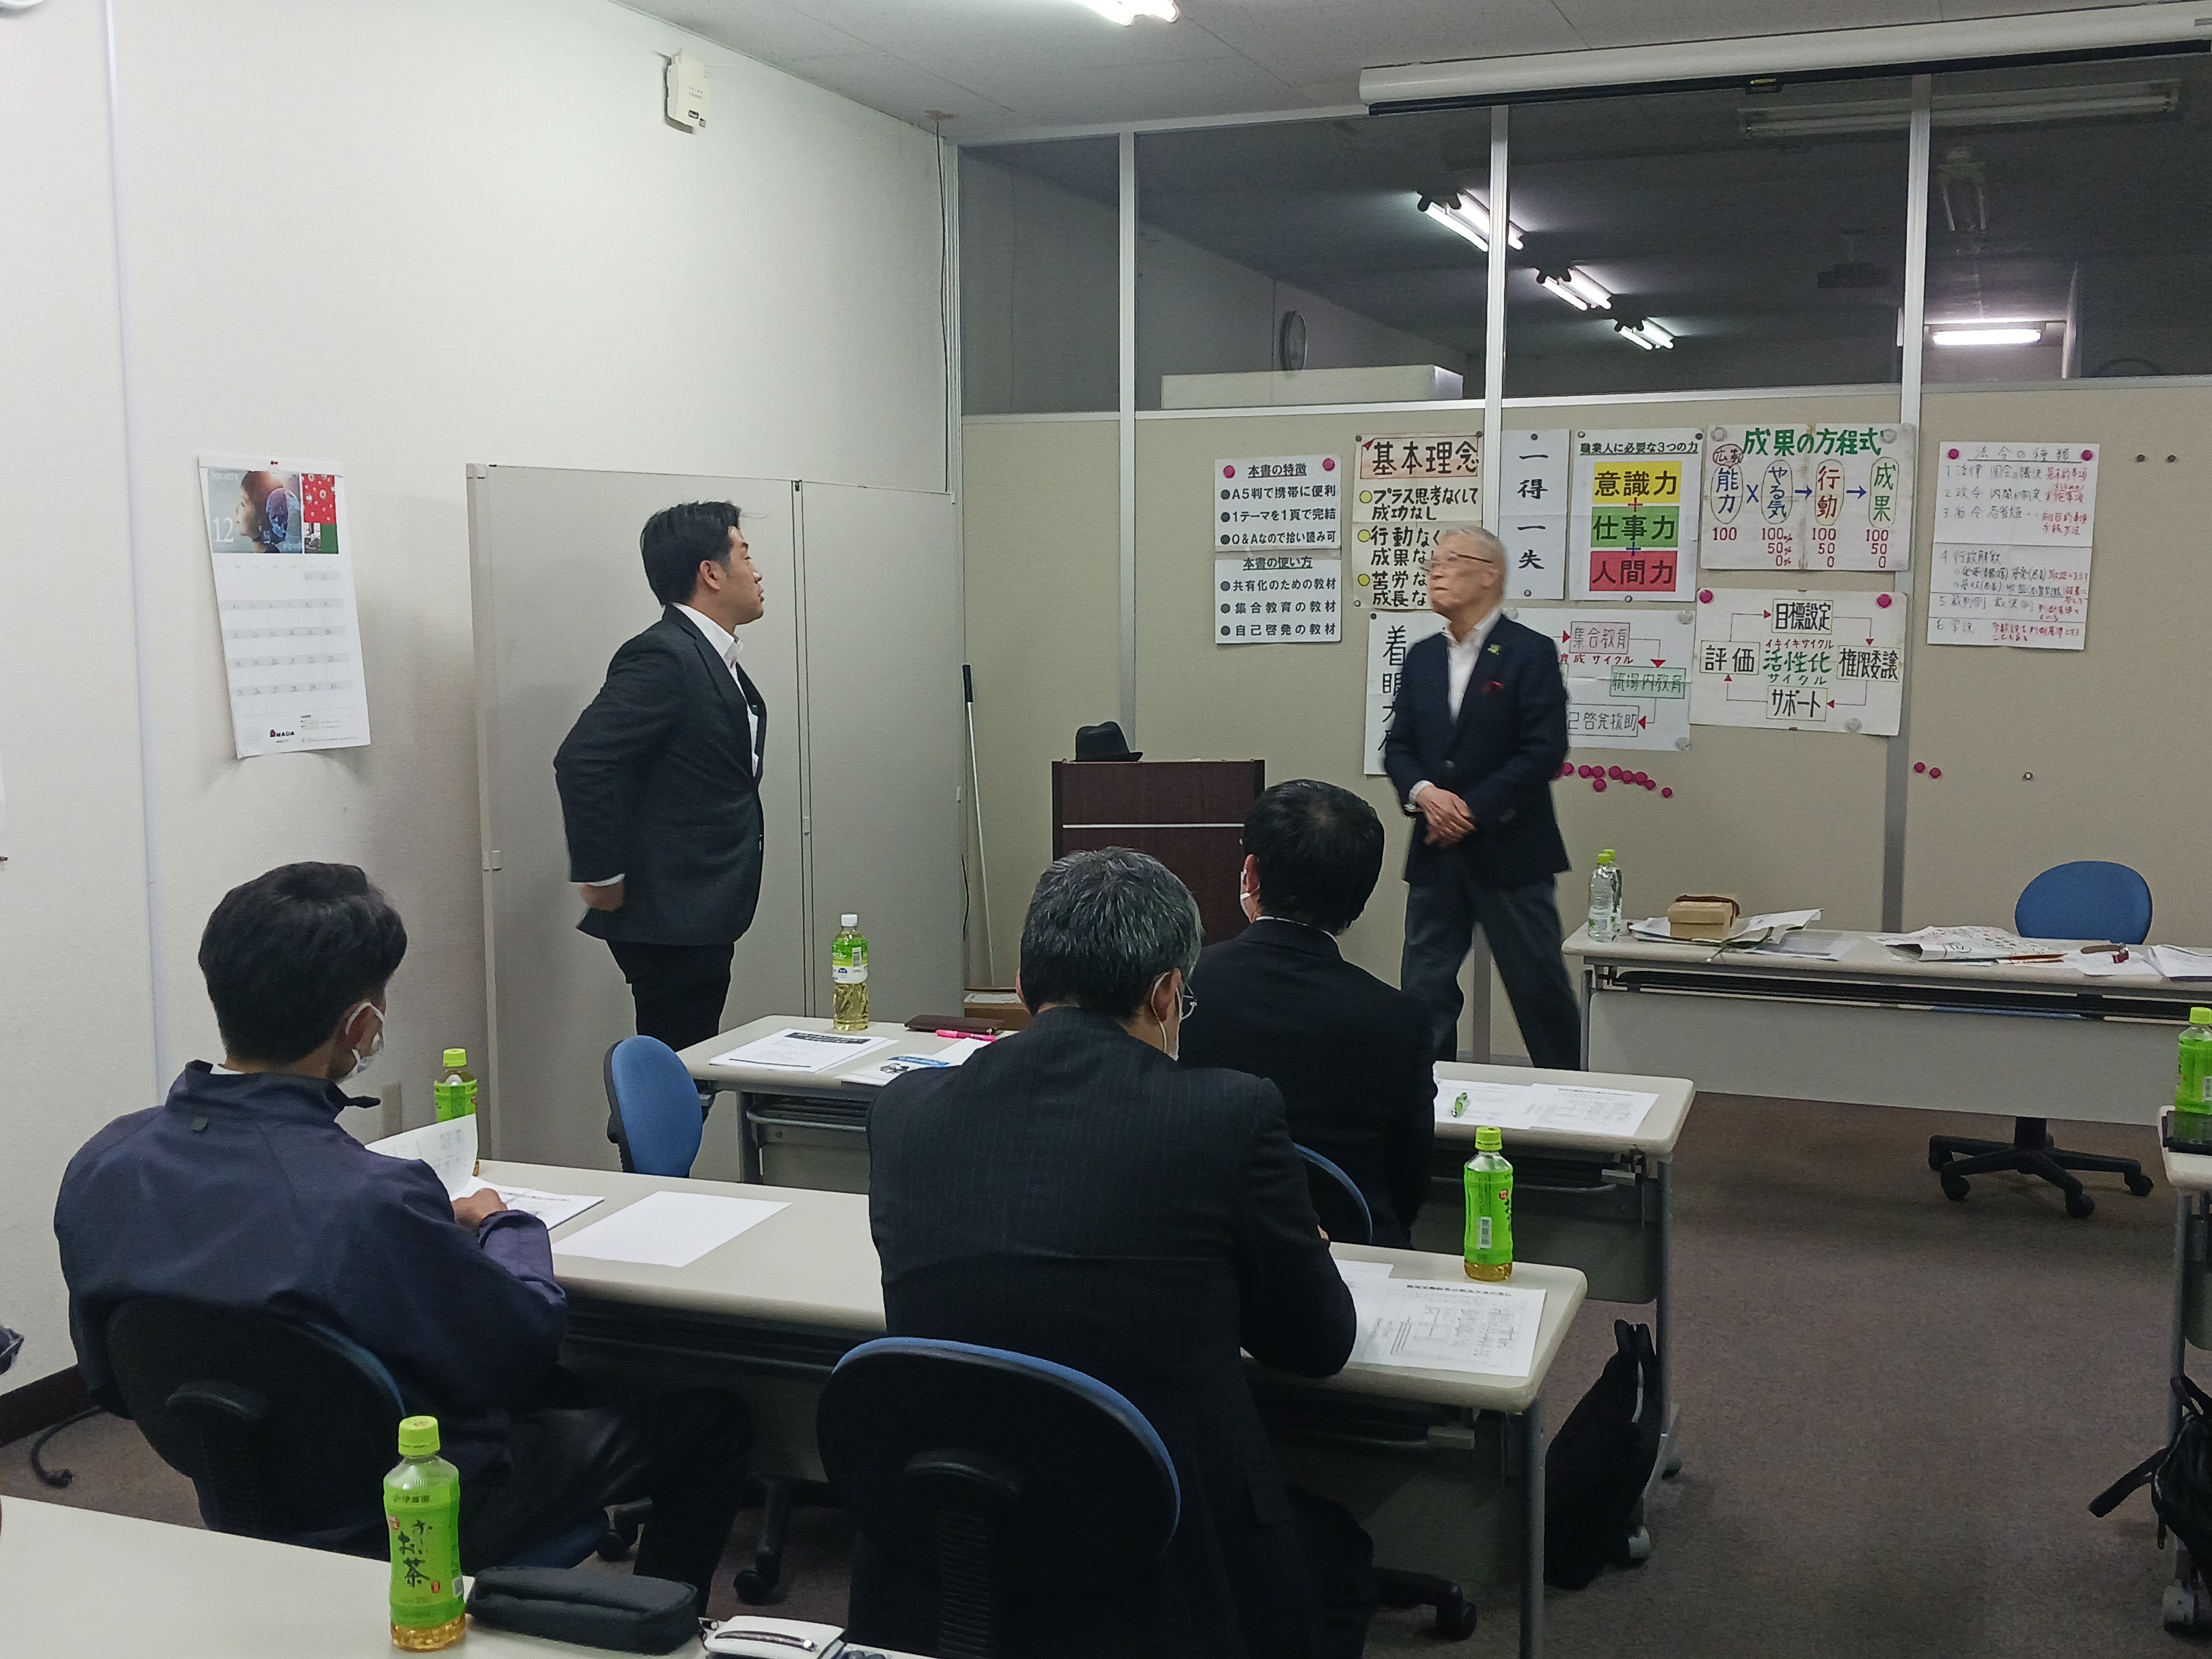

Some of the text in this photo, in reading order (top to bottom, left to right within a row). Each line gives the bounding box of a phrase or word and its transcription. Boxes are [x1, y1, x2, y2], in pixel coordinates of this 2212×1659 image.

[1742, 427, 1881, 456] 成果の方程式
[1373, 441, 1479, 475] 基本理念
[1248, 463, 1306, 477] 本書の特徴
[1232, 485, 1336, 499] A5判で携帯に便利
[1594, 471, 1677, 496] 意識力
[1716, 468, 1738, 513] 能力
[1767, 466, 1787, 518] やる気
[1817, 466, 1840, 518] 行動
[1873, 462, 1895, 522] 成果
[1373, 485, 1478, 505] プラス思考なくして
[1233, 507, 1336, 522] 1テーマを1頁で完結
[1372, 504, 1437, 521] 成功なし
[1517, 454, 1548, 570] 一得一失
[213, 517, 234, 543] 12
[1593, 515, 1675, 541] 仕事力
[1713, 527, 1737, 540] 100
[1812, 528, 1836, 540] 100
[1866, 529, 1889, 541] 100
[1818, 543, 1835, 554] 50
[1872, 543, 1887, 555] 50
[1243, 556, 1313, 569] 本書の使い方
[1827, 556, 1834, 567] 0
[1879, 556, 1886, 568] 0
[1592, 560, 1673, 584] 人間力
[1233, 577, 1336, 591] 共有化のための教材
[1235, 601, 1336, 614] 集合教育の教材
[1775, 602, 1831, 631] 目標設定
[1236, 623, 1336, 636] 自己啓発の教材
[1573, 626, 1627, 650] 集合教育
[1766, 639, 1834, 650] イキイキサイクル
[1705, 645, 1754, 673] 評価
[1763, 648, 1832, 673] 活性化
[1838, 647, 1899, 680] 権限委譲
[1612, 672, 1683, 693] 職場内教育
[1767, 674, 1827, 685] サイクル
[1772, 689, 1821, 717] サポート
